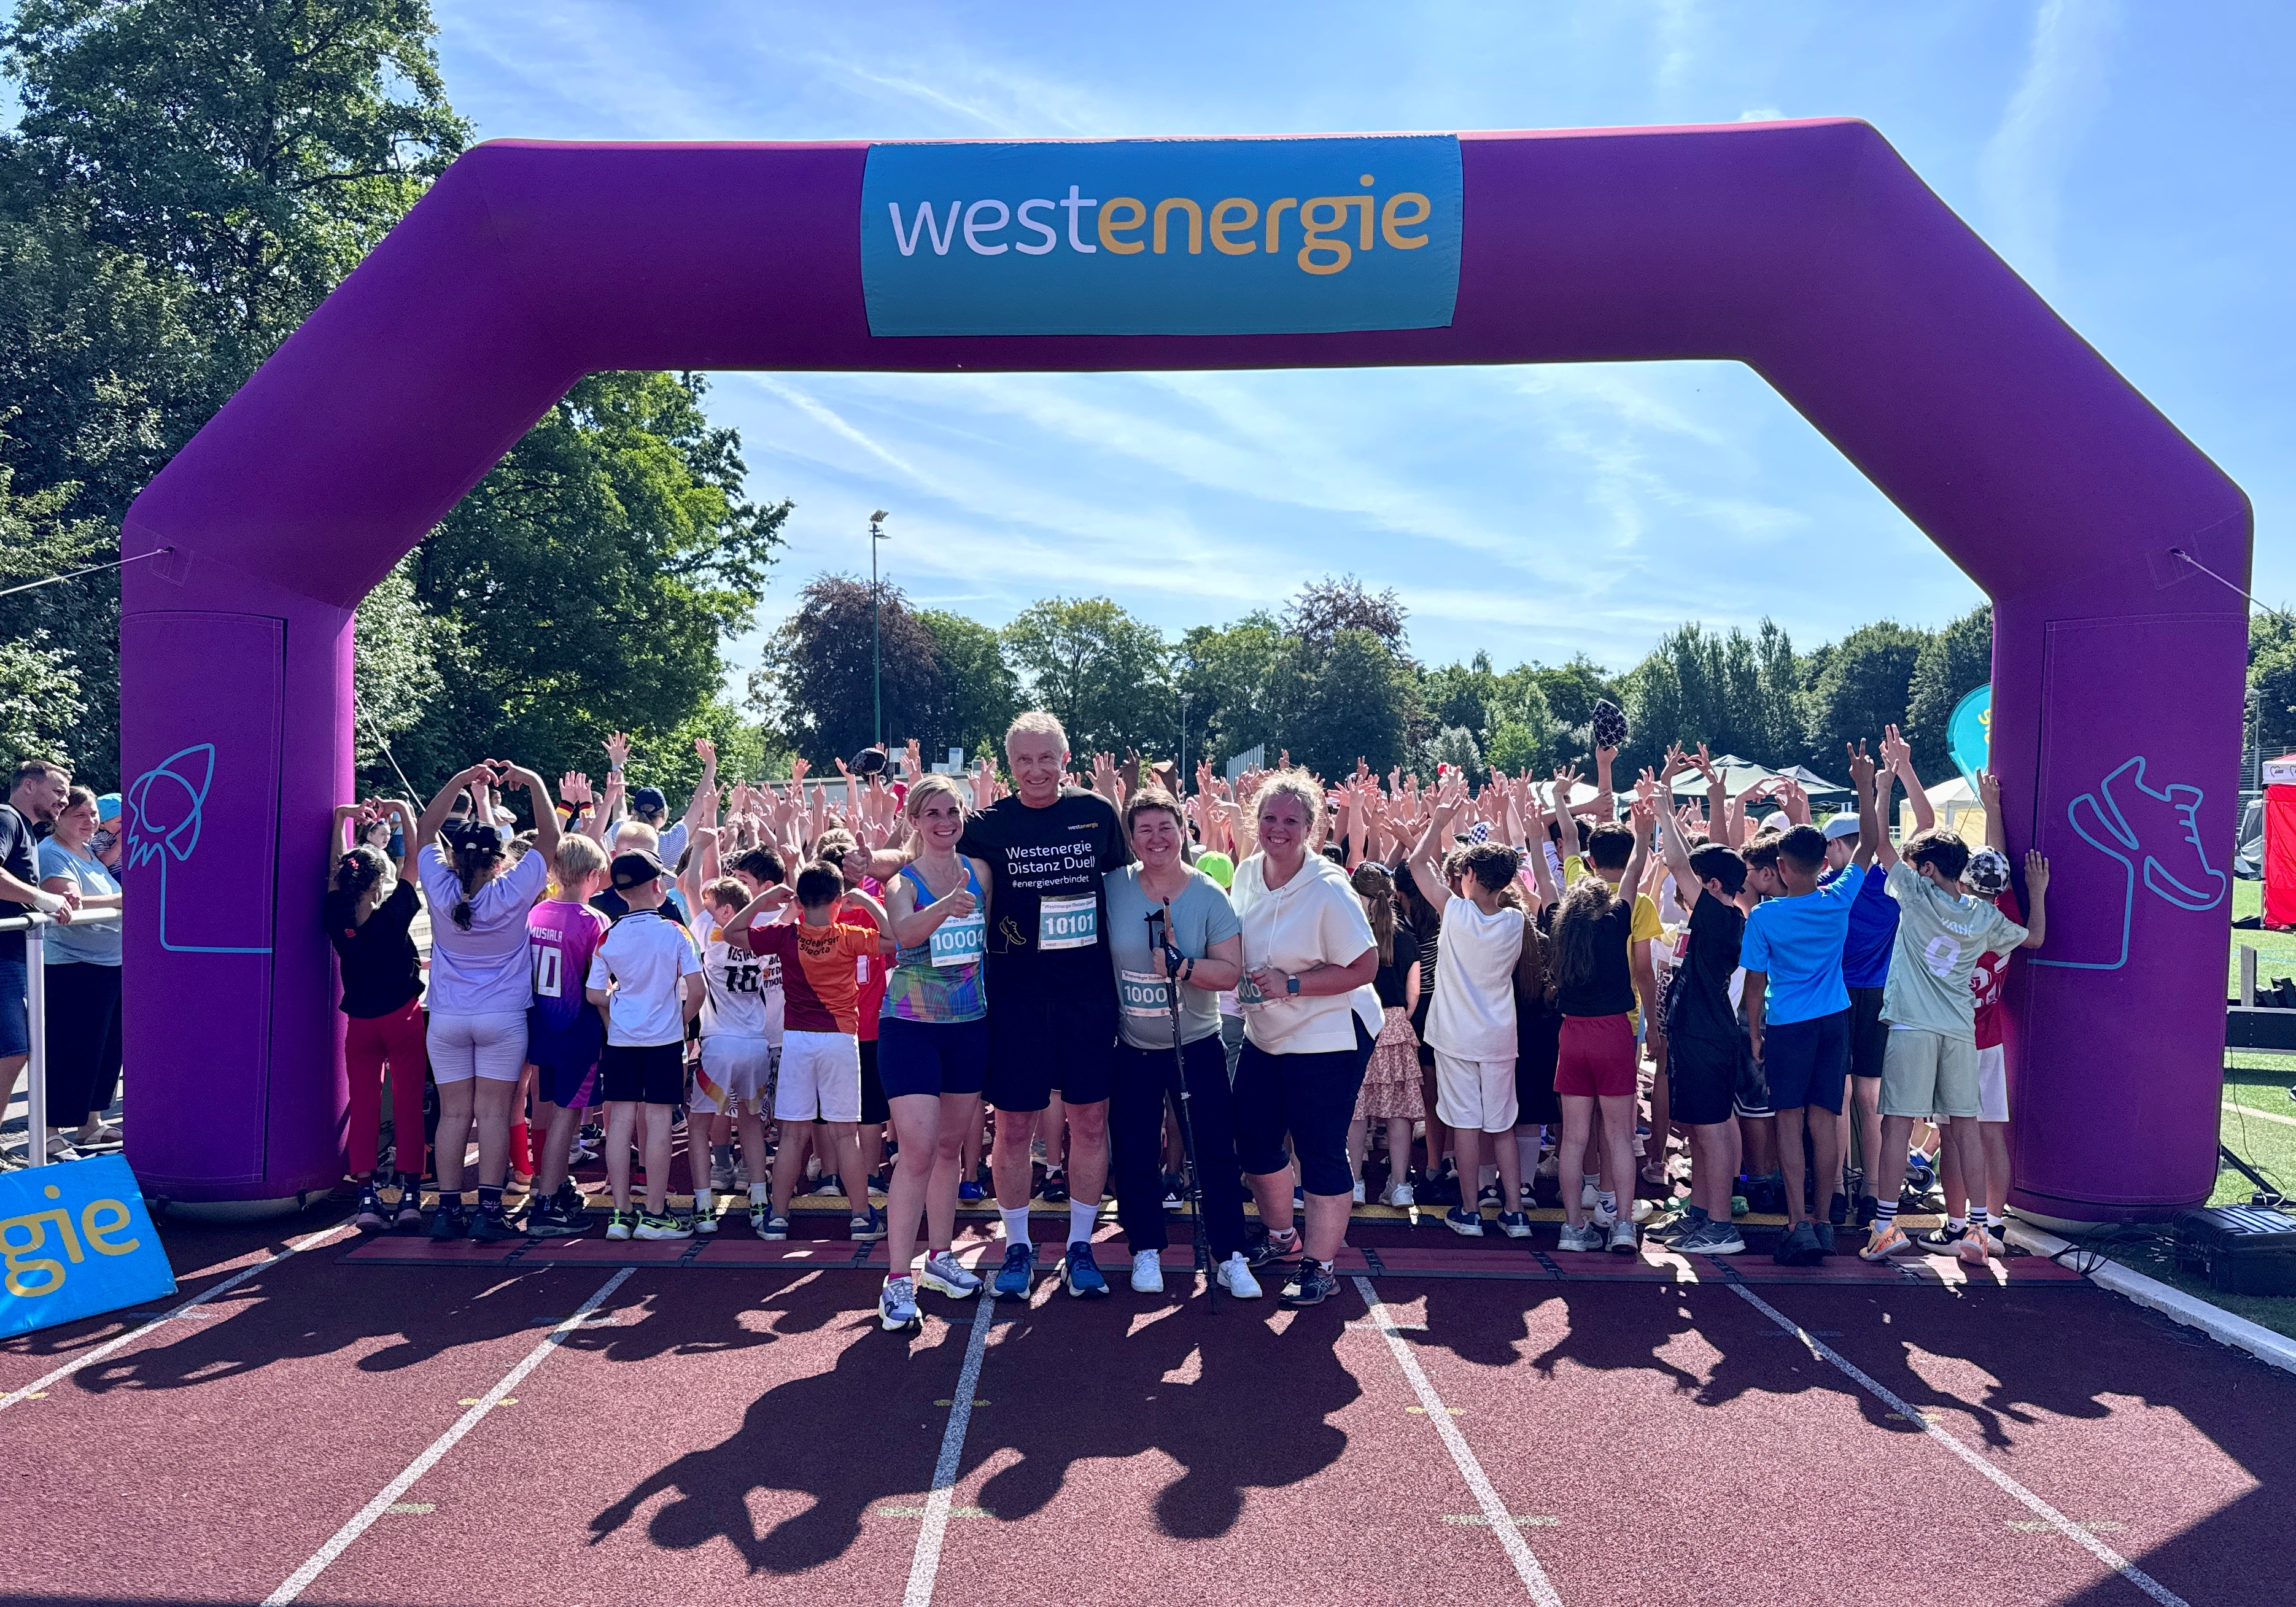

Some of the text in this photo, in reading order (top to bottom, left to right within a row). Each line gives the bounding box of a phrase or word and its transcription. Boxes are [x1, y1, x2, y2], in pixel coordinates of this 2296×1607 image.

[888, 174, 1431, 275] westenergie
[1068, 821, 1098, 830] westenergie
[1006, 840, 1092, 860] Westenergie
[1007, 856, 1095, 875] Distanz Duell
[1012, 874, 1090, 888] #energieverbindet
[1045, 913, 1093, 935] 10101
[530, 926, 563, 943] MUSIALA
[931, 929, 983, 951] 10004
[530, 944, 562, 998] 10
[724, 964, 762, 994] 10
[1125, 985, 1180, 1004] 1000
